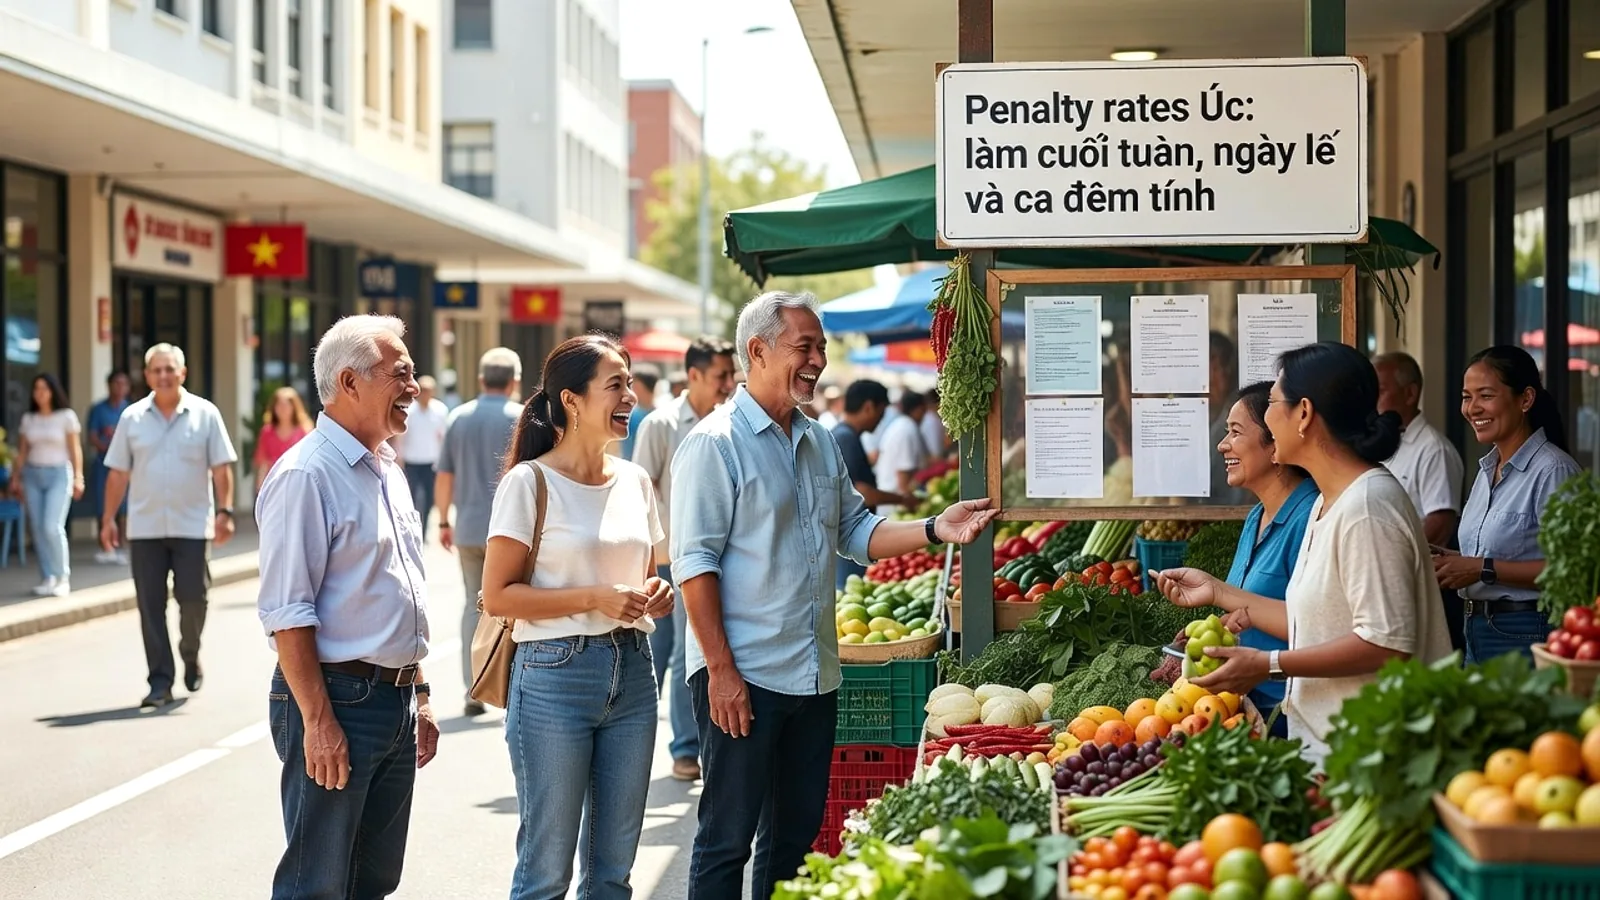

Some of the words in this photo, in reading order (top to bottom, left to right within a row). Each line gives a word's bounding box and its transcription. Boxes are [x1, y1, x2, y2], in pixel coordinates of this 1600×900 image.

[965, 91, 1094, 133] Penalty
[1103, 93, 1190, 123] rates
[1200, 82, 1254, 122] Úc:
[965, 137, 1028, 170] làm
[1037, 132, 1109, 169] cuối
[1117, 135, 1204, 173] tuàn,
[1213, 133, 1297, 175] ngày
[1306, 129, 1341, 165] lế
[964, 182, 1004, 214] và
[1014, 190, 1053, 214] ca
[1063, 180, 1139, 213] đêm
[1148, 178, 1215, 212] tính
